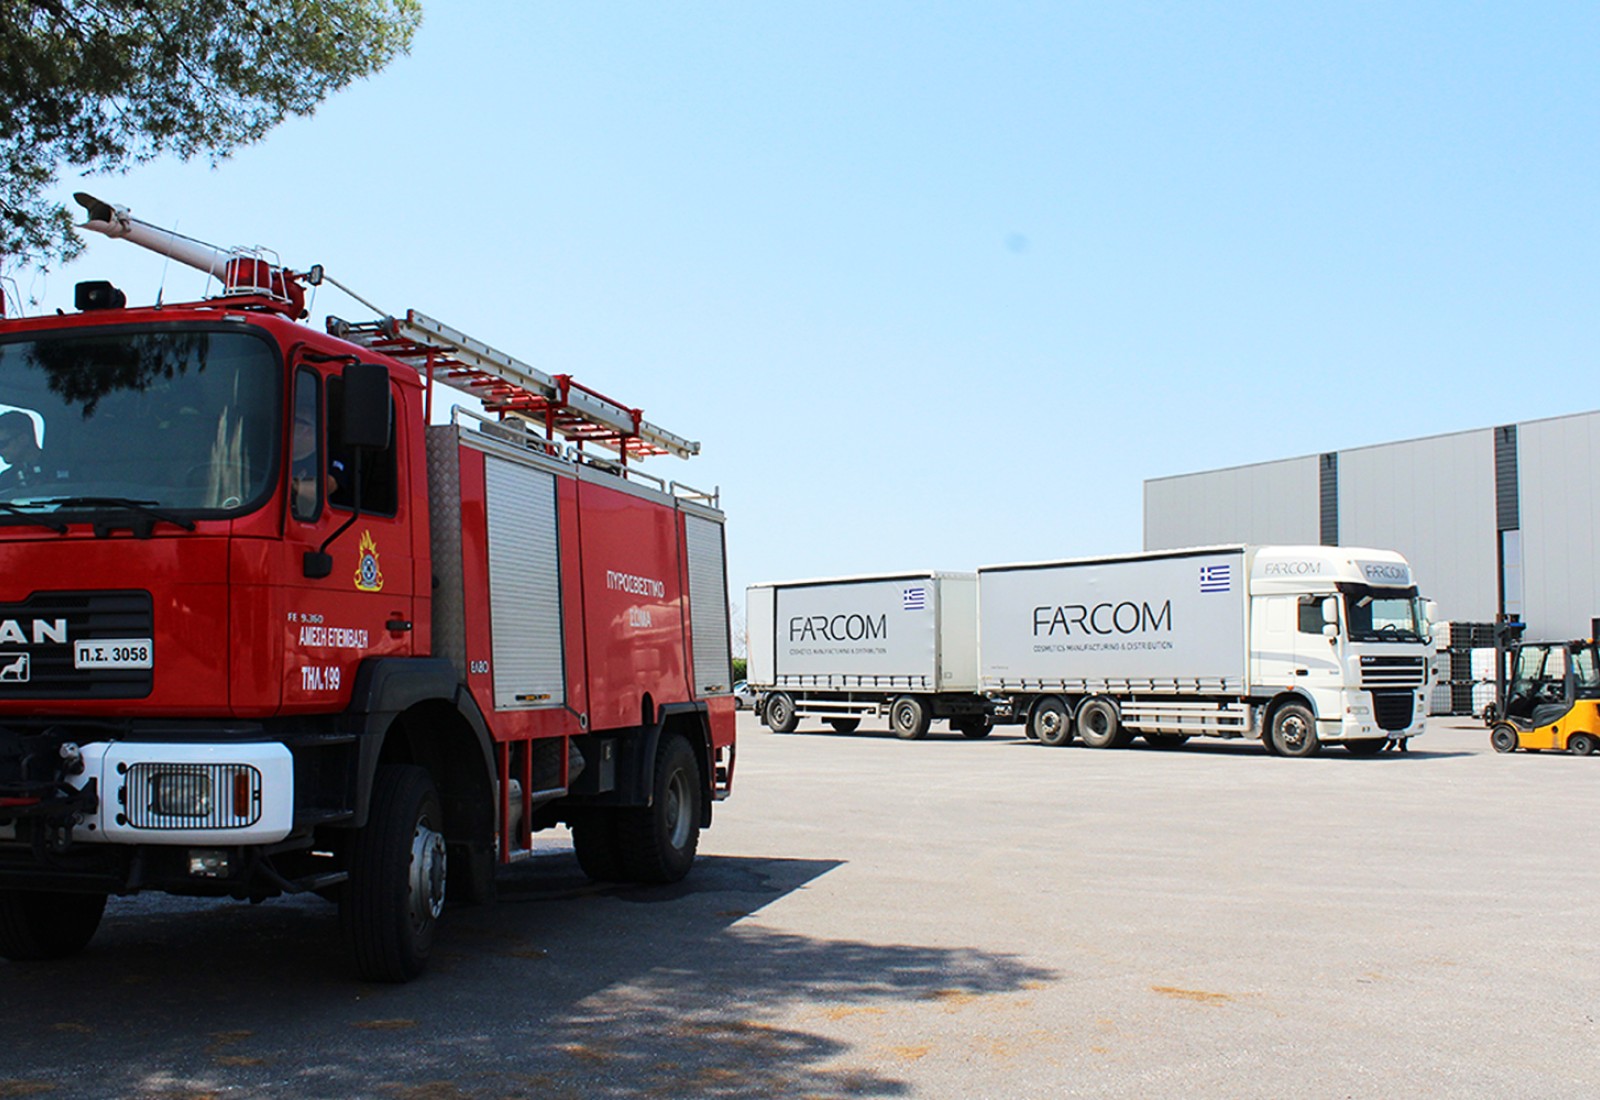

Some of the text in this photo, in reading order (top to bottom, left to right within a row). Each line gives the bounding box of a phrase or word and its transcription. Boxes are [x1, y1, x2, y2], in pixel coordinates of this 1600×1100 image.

[1264, 561, 1321, 575] FARCOM
[1366, 564, 1405, 579] FARCOM
[1033, 599, 1171, 636] FARCOM
[789, 613, 887, 641] FARCOM
[112, 647, 148, 662] 3058
